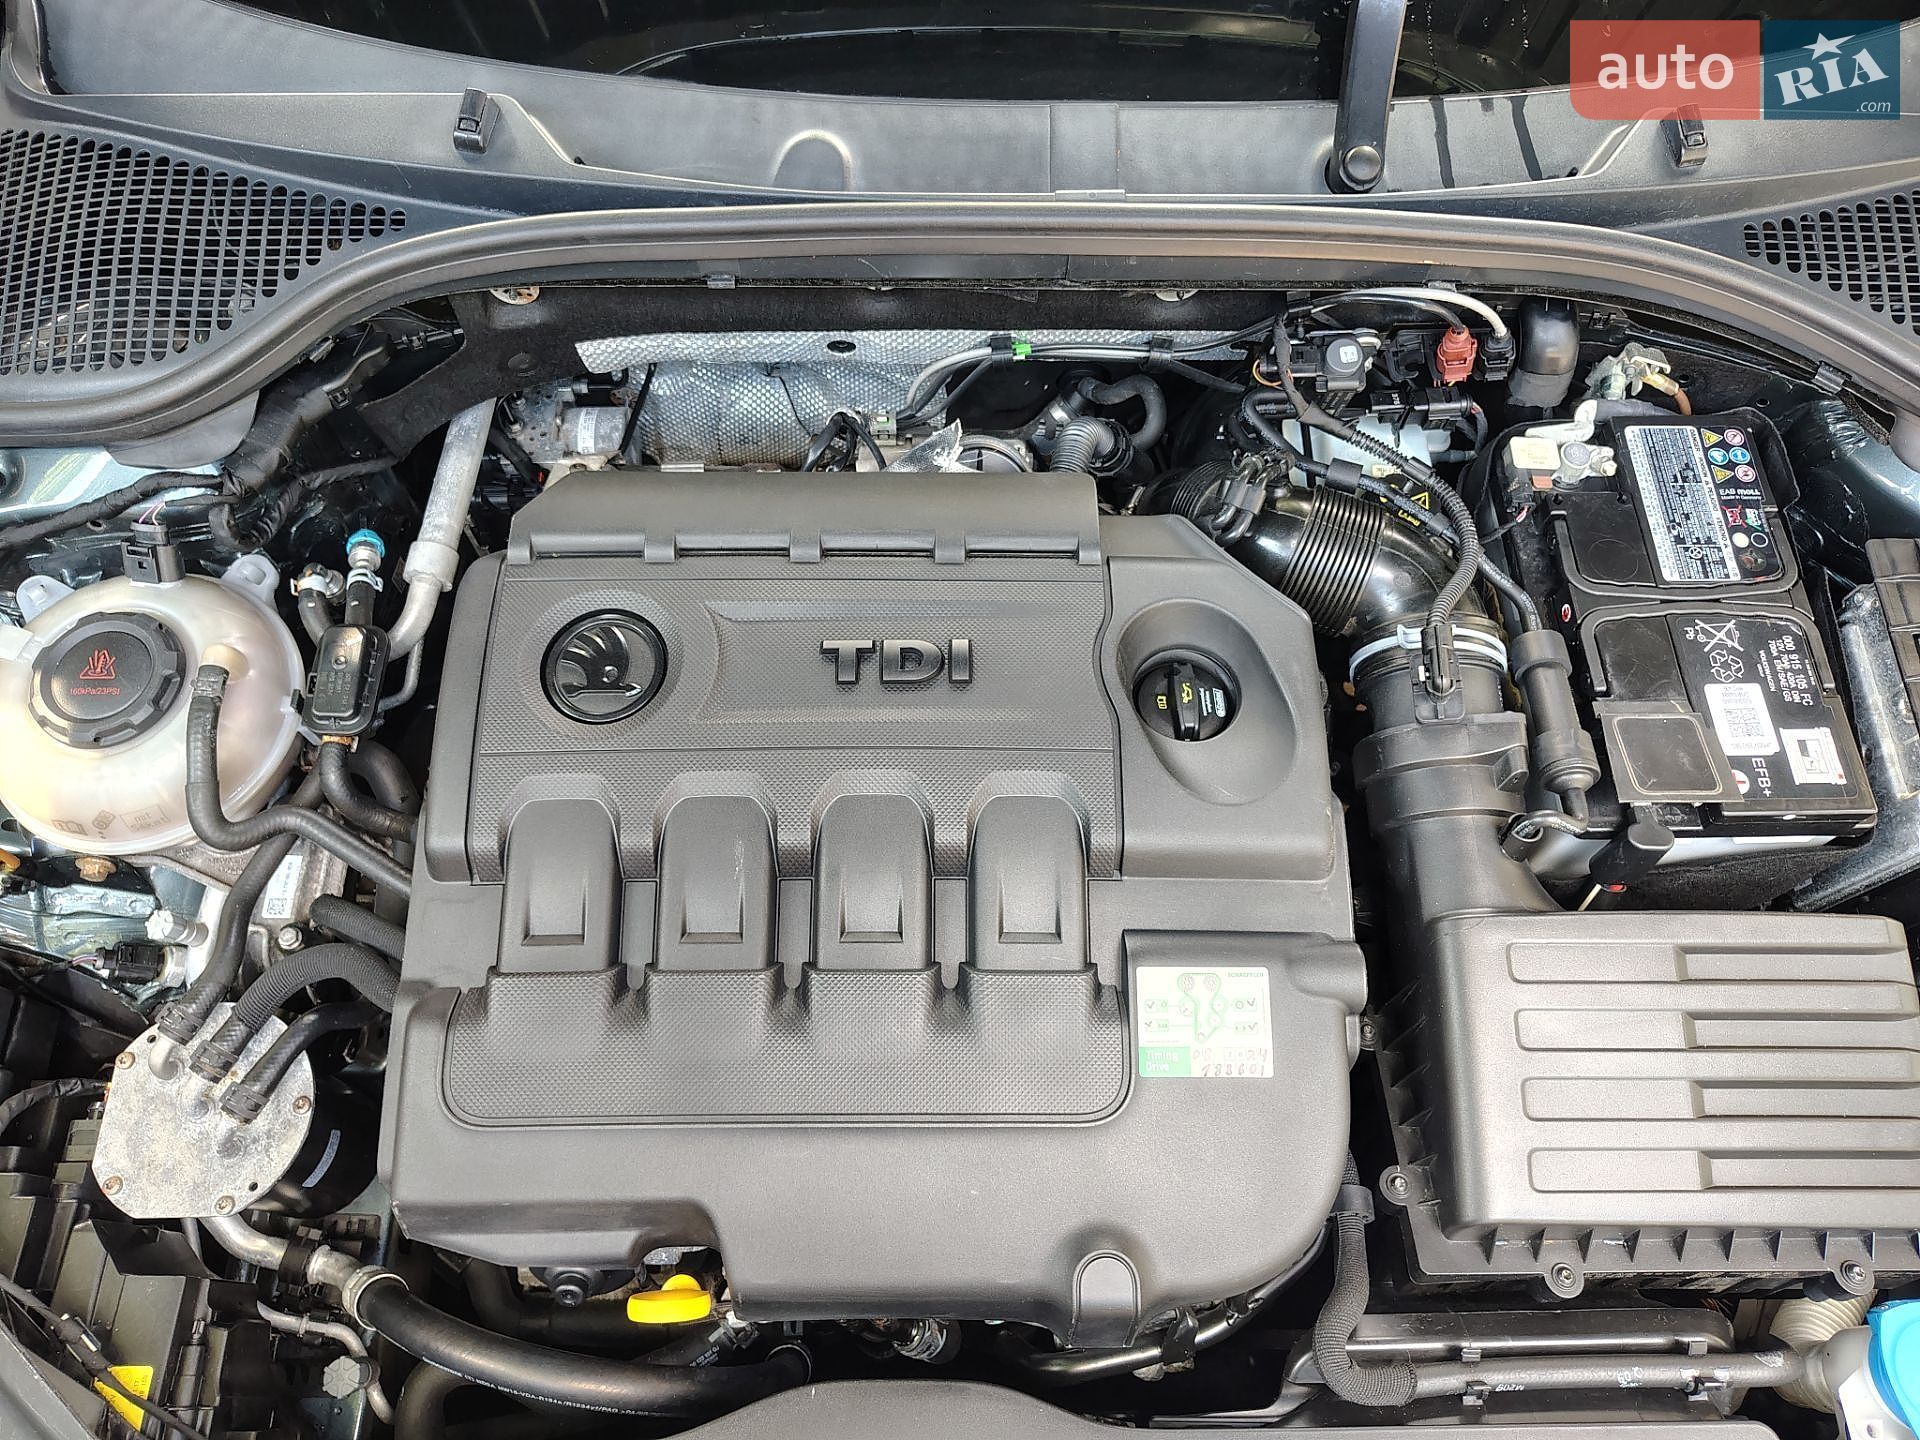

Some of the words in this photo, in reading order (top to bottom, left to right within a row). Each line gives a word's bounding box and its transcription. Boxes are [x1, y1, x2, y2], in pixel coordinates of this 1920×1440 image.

[1683, 627, 1695, 640] Pb
[1775, 639, 1786, 652] 12V
[1782, 635, 1796, 651] 000
[820, 639, 973, 685] TDI
[1788, 654, 1802, 670] 915
[1795, 674, 1808, 690] 105
[1800, 693, 1813, 706] FC
[1751, 757, 1772, 798] EFB+
